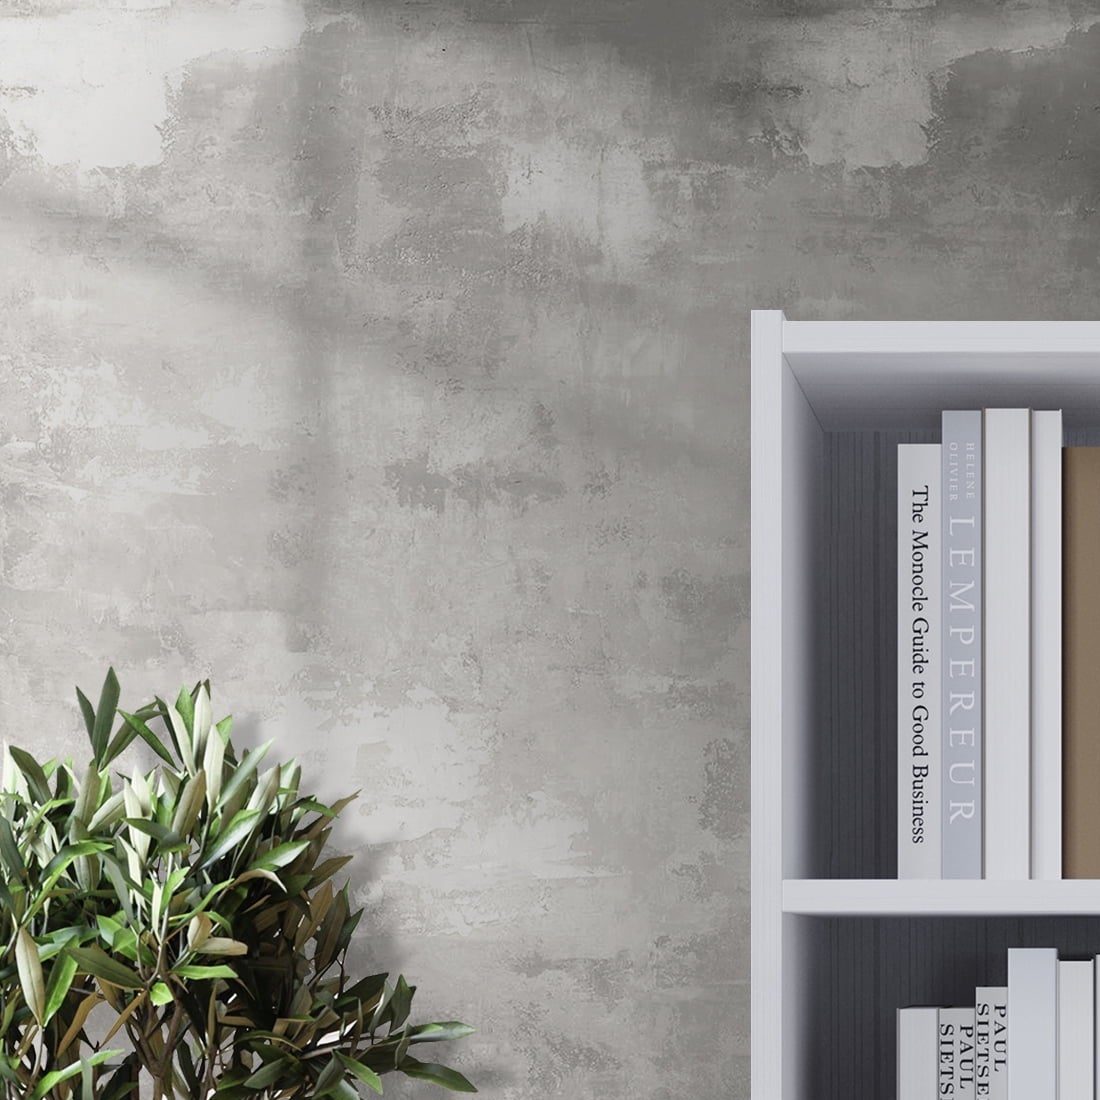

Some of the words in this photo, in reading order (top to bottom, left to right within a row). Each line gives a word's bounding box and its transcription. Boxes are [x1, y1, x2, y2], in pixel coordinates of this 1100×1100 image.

[949, 442, 958, 501] OLIVIER
[911, 485, 929, 523] The
[911, 530, 929, 611] Monocle
[911, 617, 929, 674] Guide
[949, 516, 975, 824] LEMPEREUR
[911, 682, 927, 698] to
[911, 705, 929, 756] Good
[911, 764, 929, 844] Business
[960, 1024, 973, 1090] PAUL
[994, 1004, 1006, 1072] PAUL
